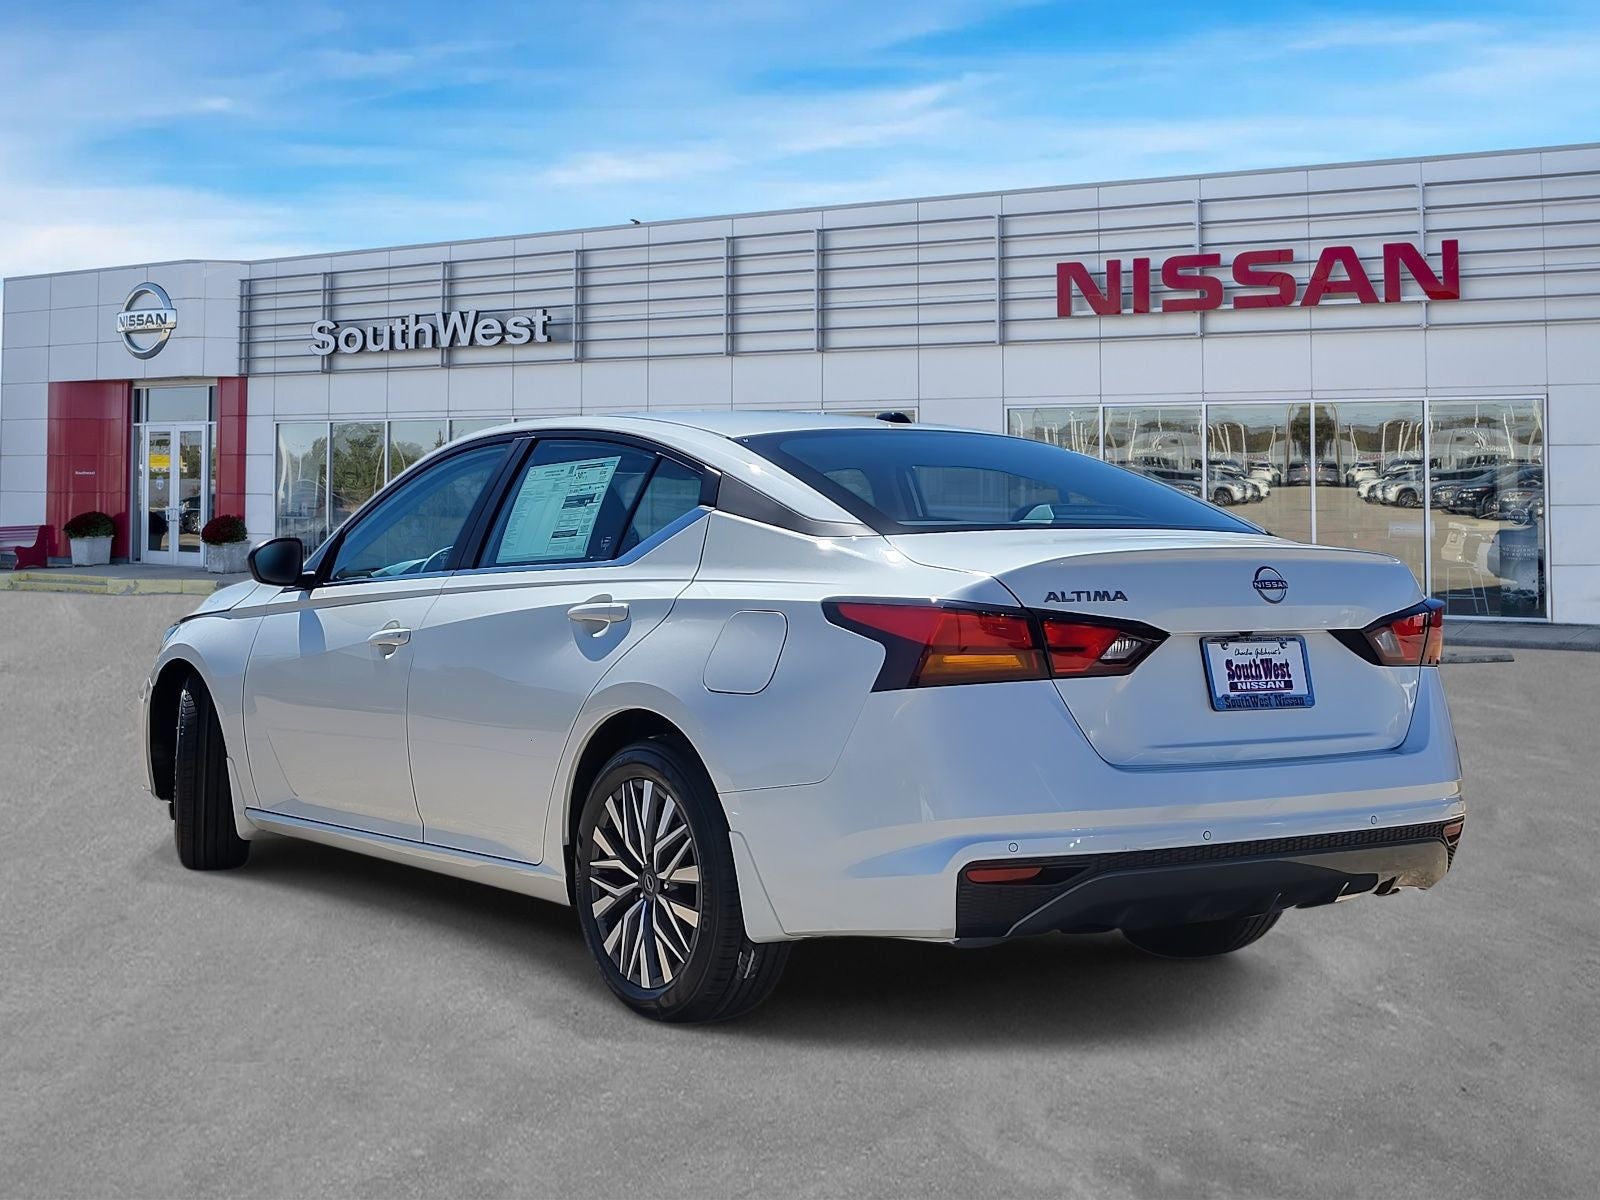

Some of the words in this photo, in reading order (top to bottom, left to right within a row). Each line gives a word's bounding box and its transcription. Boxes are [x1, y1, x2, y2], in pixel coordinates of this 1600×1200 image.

[1057, 239, 1461, 318] NISSAN
[119, 312, 168, 328] NISSAN
[309, 308, 552, 356] SouthWest
[1253, 580, 1288, 589] NISSAN
[1043, 590, 1128, 603] ALTIMA
[1225, 658, 1291, 680] SouthWest
[1237, 681, 1285, 690] NISSAN
[1224, 695, 1273, 709] SouthWest
[1275, 695, 1305, 706] Nissan
